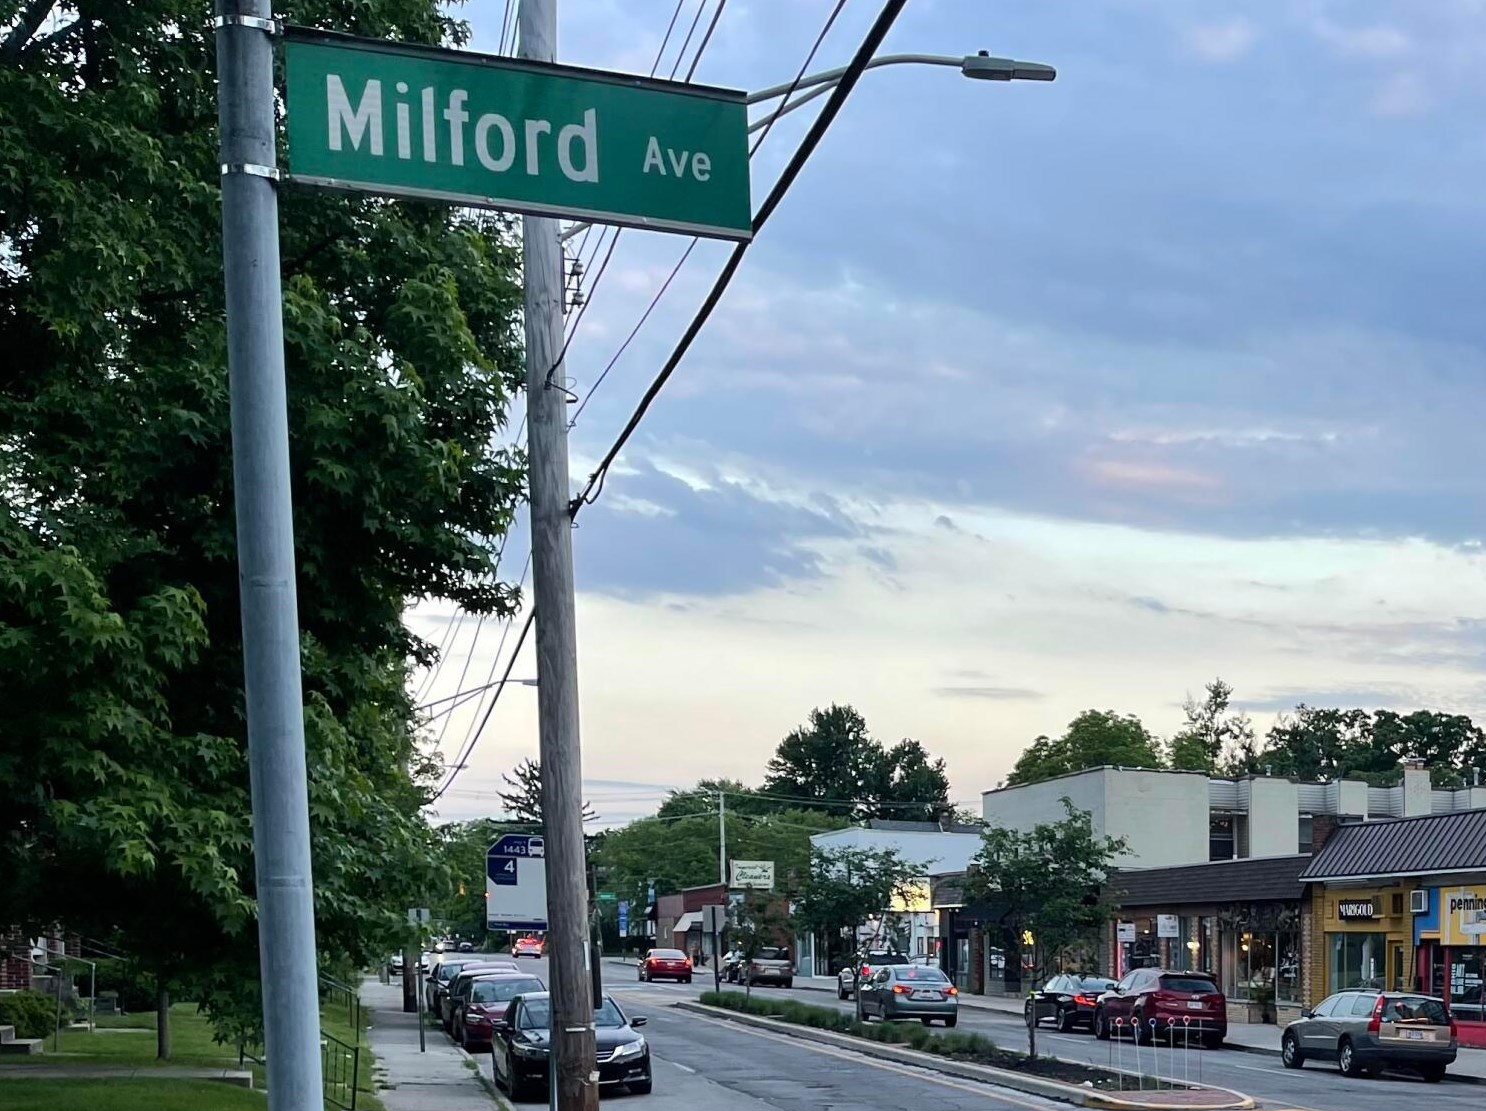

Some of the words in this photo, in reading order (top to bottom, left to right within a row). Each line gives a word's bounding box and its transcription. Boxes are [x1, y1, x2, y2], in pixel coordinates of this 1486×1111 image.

[326, 74, 599, 184] Milford
[643, 136, 712, 182] Ave
[504, 845, 527, 854] 1443
[504, 860, 515, 873] 4
[1340, 903, 1374, 916] MARIGOLD
